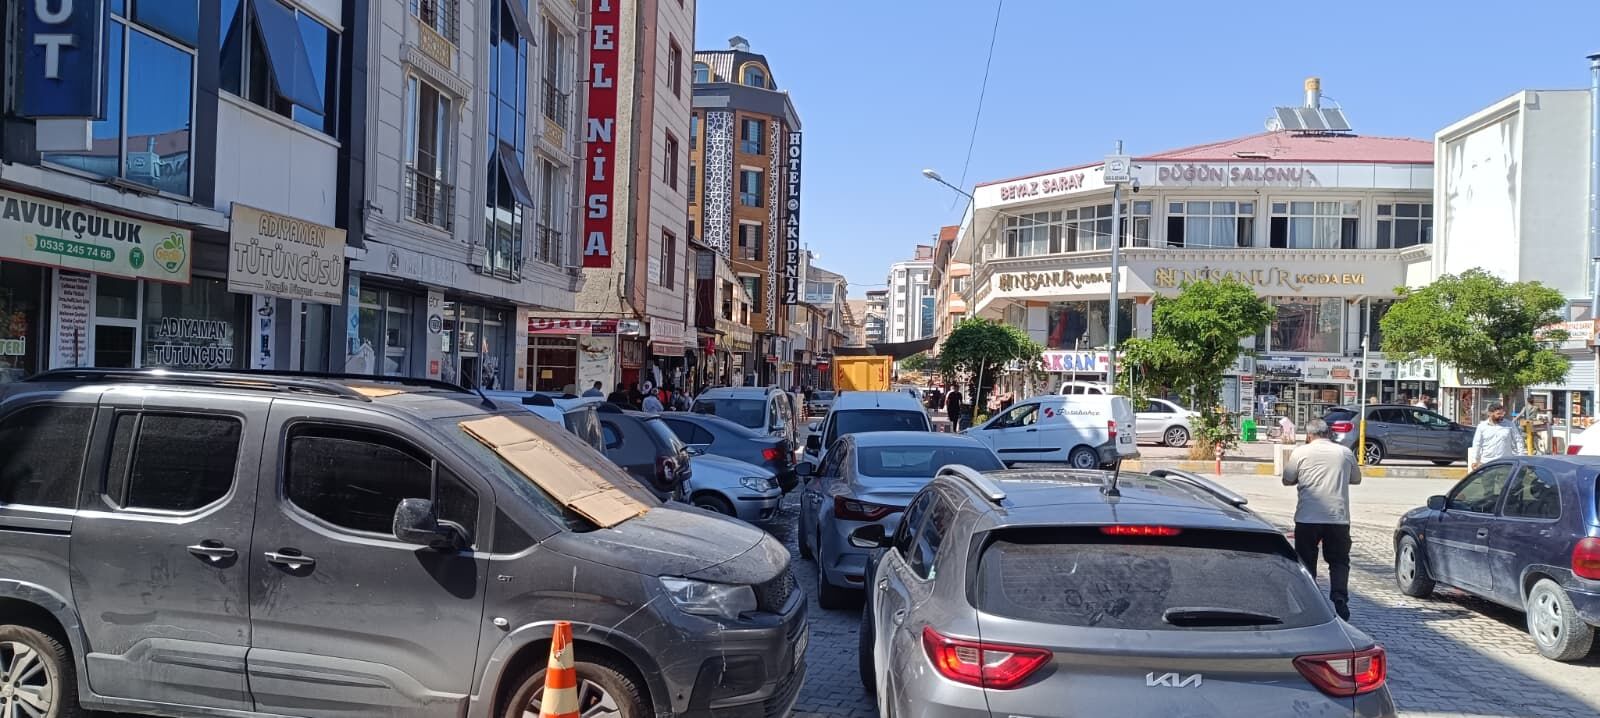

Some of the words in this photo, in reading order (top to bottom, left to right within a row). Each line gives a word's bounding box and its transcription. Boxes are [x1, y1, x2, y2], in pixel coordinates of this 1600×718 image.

[788, 133, 800, 197] HOTEL
[1158, 164, 1223, 182] DÜĞÜN
[1230, 166, 1304, 182] SALONU
[1000, 182, 1039, 200] BEYAZ
[1041, 172, 1085, 194] SARAY
[259, 214, 326, 248] ADIYAMAN
[40, 240, 65, 251] 0535
[67, 244, 85, 256] 245
[87, 248, 98, 257] 74
[100, 249, 112, 260] 68
[786, 213, 799, 304] AKDENİZ
[234, 237, 341, 287] TÜTÜNCÜSÜ
[1296, 273, 1337, 284] MODA
[160, 317, 227, 339] ADIYAMAN
[153, 341, 234, 366] TÜTÜNCÜSÜ
[1043, 354, 1096, 371] AKSAN
[1146, 671, 1202, 689] KIA
